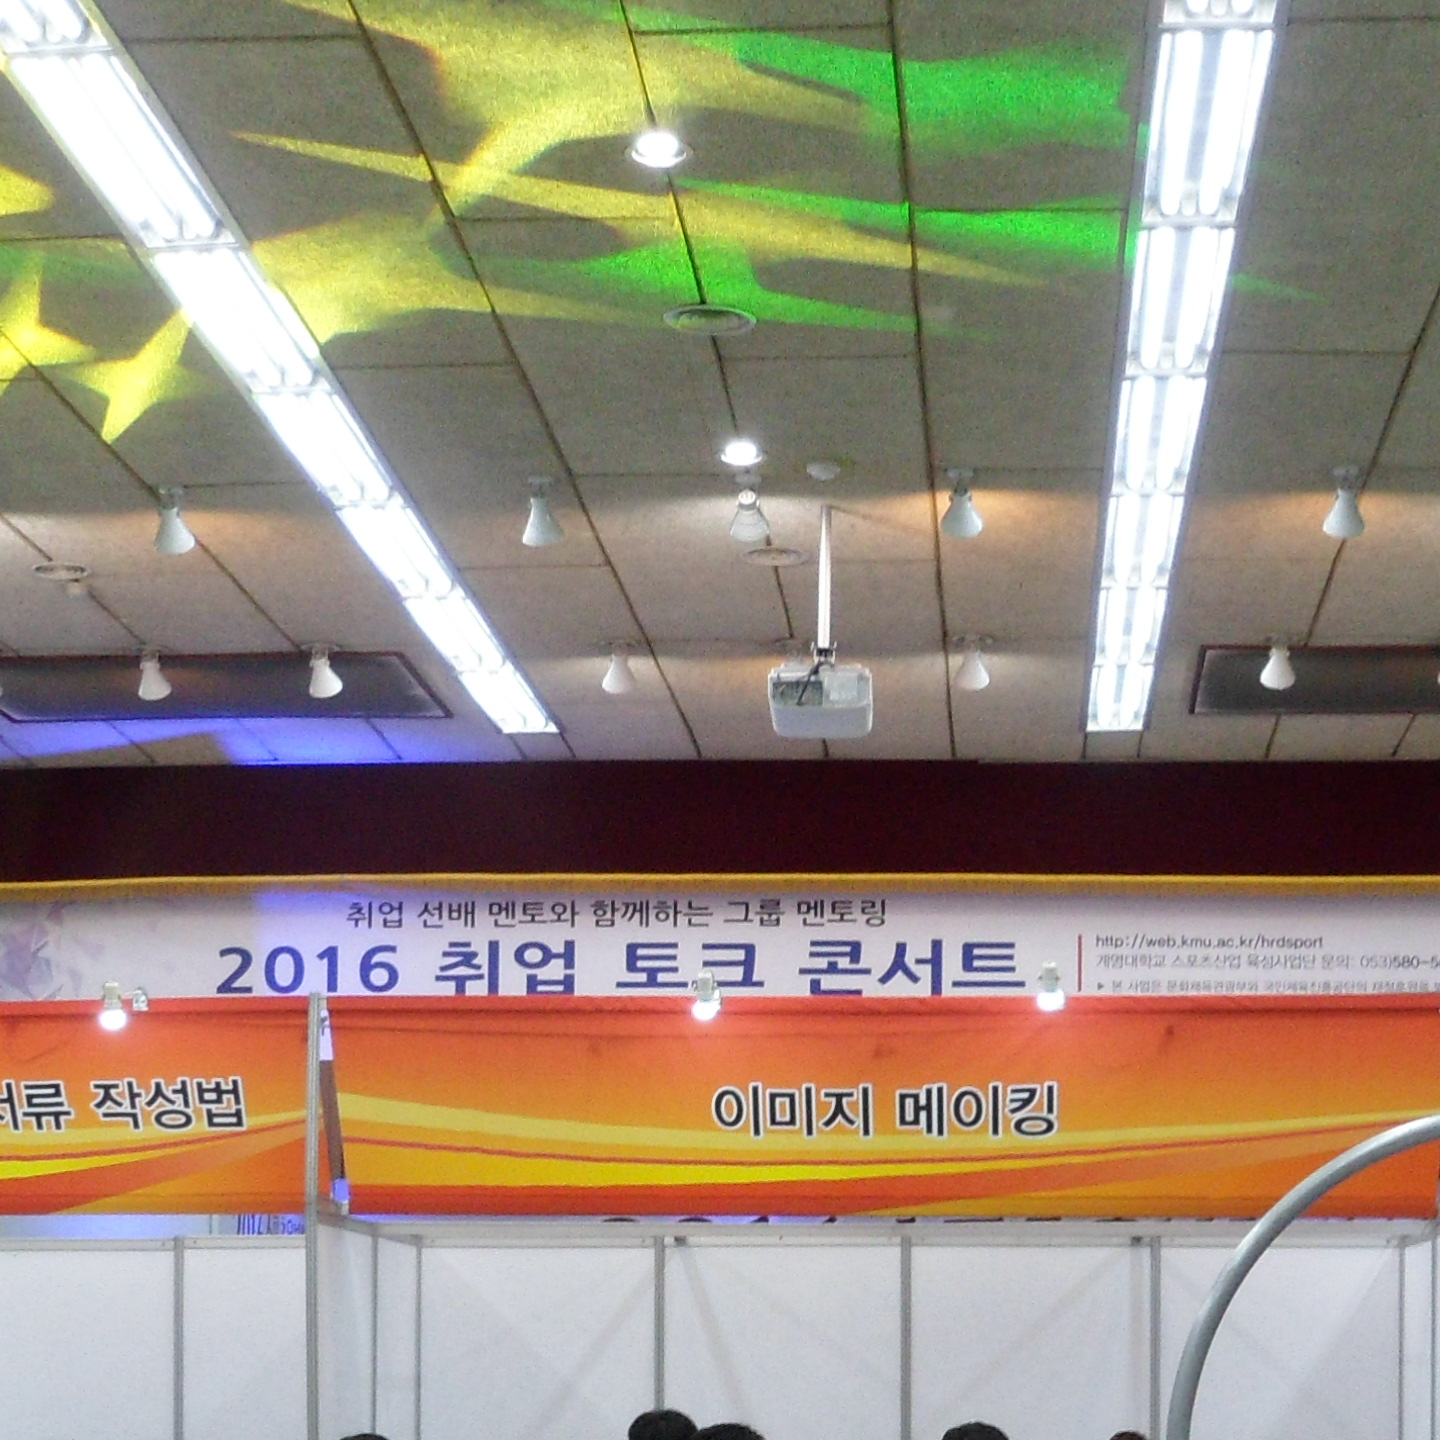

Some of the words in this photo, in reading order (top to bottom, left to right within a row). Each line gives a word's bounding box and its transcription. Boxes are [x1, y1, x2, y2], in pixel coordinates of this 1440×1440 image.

[346, 901, 404, 928] 취업
[417, 901, 477, 928] 선배
[488, 901, 580, 928] 멘토와
[592, 900, 714, 928] 함께하는
[723, 899, 785, 928] 그룹
[796, 898, 887, 928] 멘토링
[215, 944, 400, 995] 2016
[434, 940, 576, 996] 취업
[615, 941, 765, 989] 토크
[798, 938, 1027, 996] 콘서트
[90, 1076, 247, 1131] 작성법
[712, 1081, 873, 1138] 이미지
[895, 1080, 1058, 1138] 메이킹
